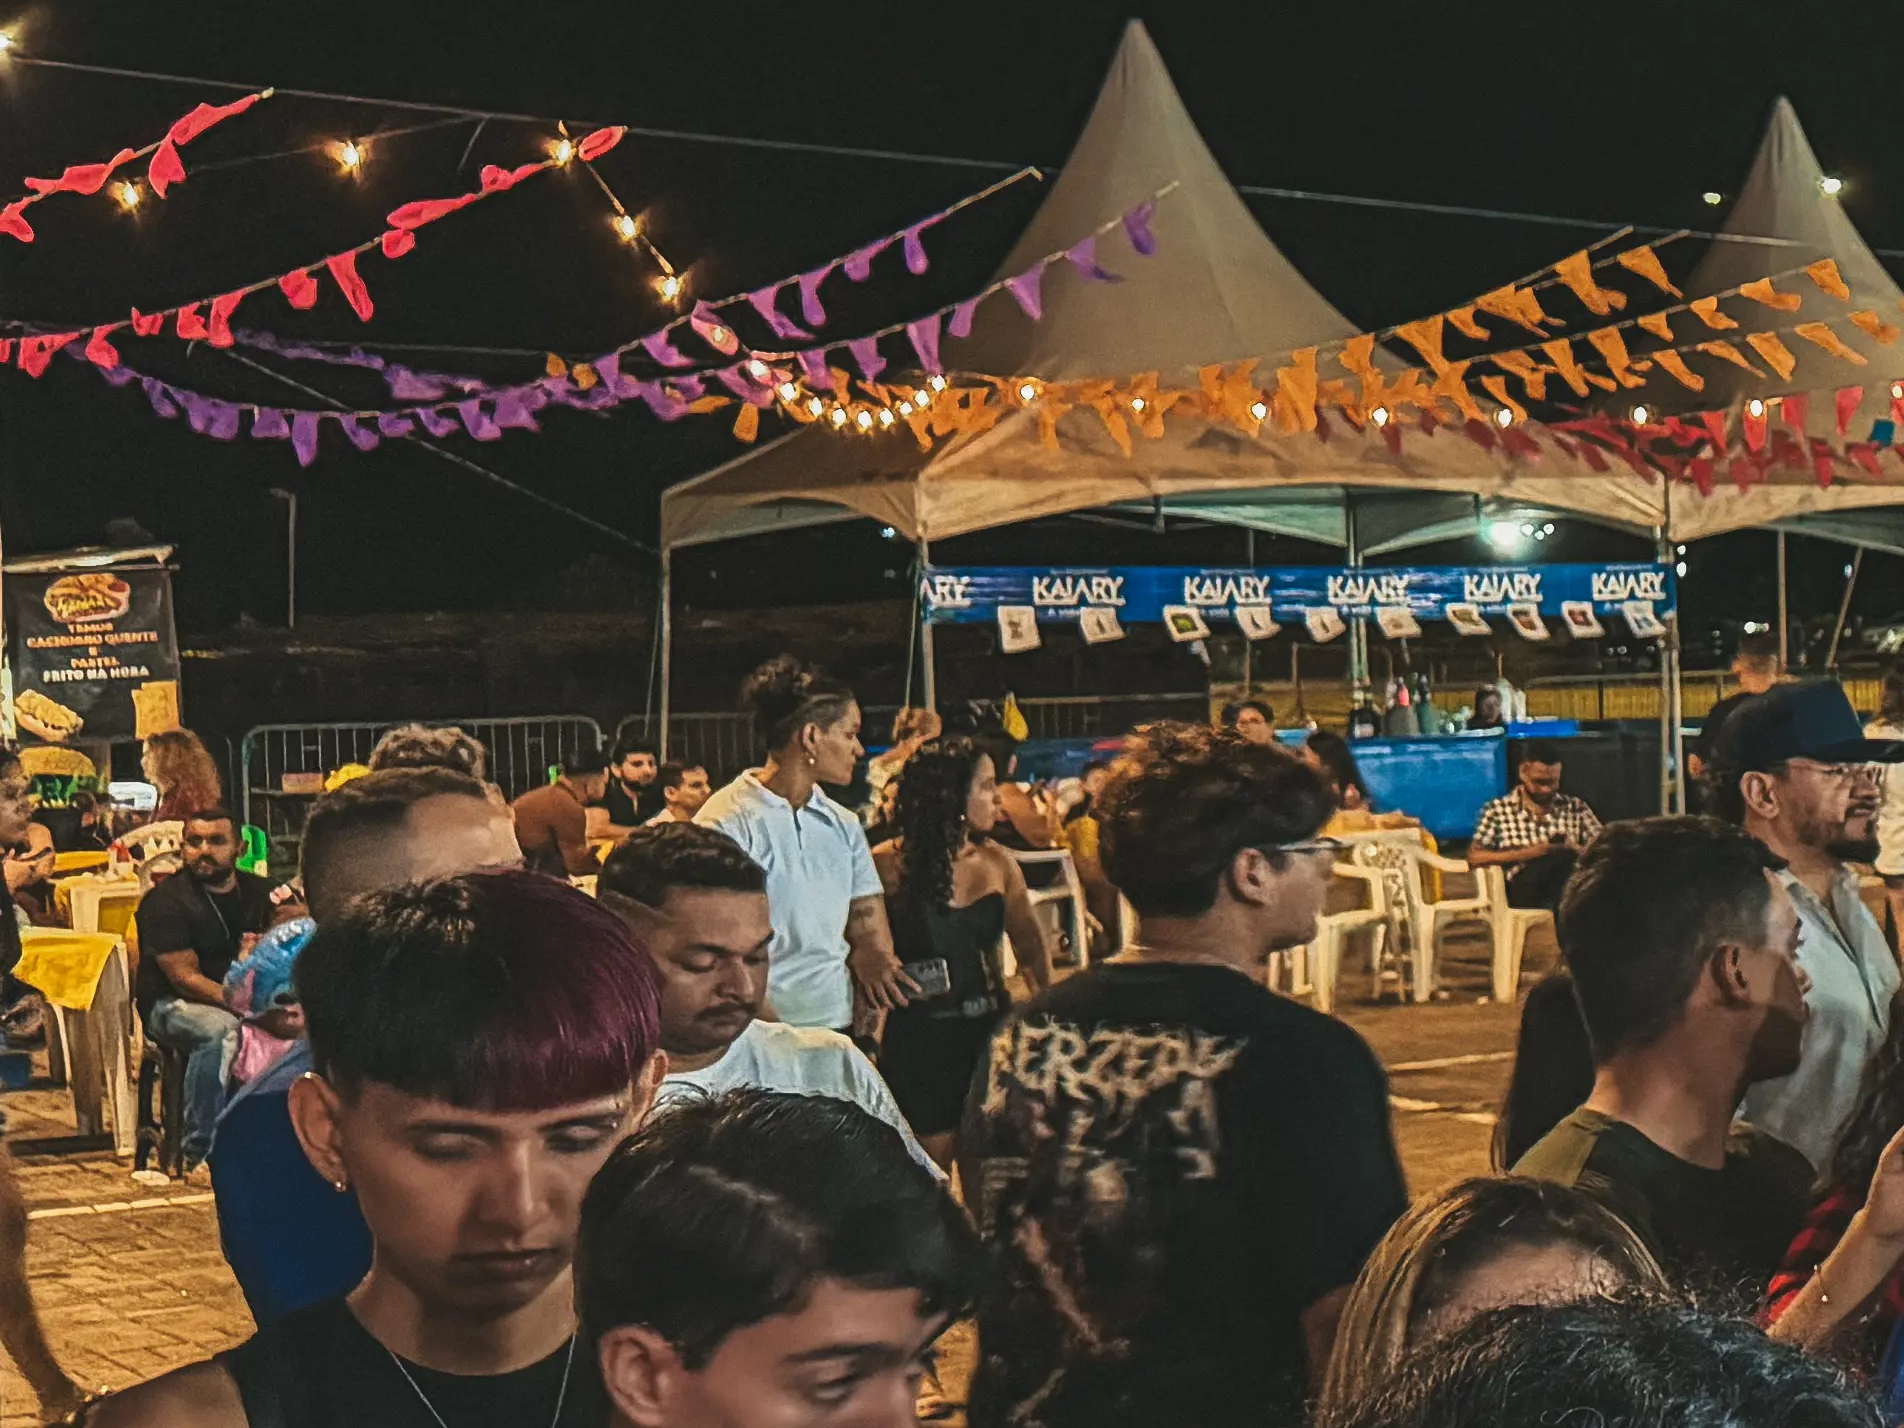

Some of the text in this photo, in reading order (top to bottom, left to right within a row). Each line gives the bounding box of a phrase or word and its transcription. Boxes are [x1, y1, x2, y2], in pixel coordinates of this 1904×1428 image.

[1033, 575, 1126, 606] KAIARY
[1184, 575, 1272, 605] KAIARY
[1327, 575, 1411, 605] KAIARY
[1464, 572, 1543, 603] KAIARY
[1592, 571, 1667, 601] KAIARY
